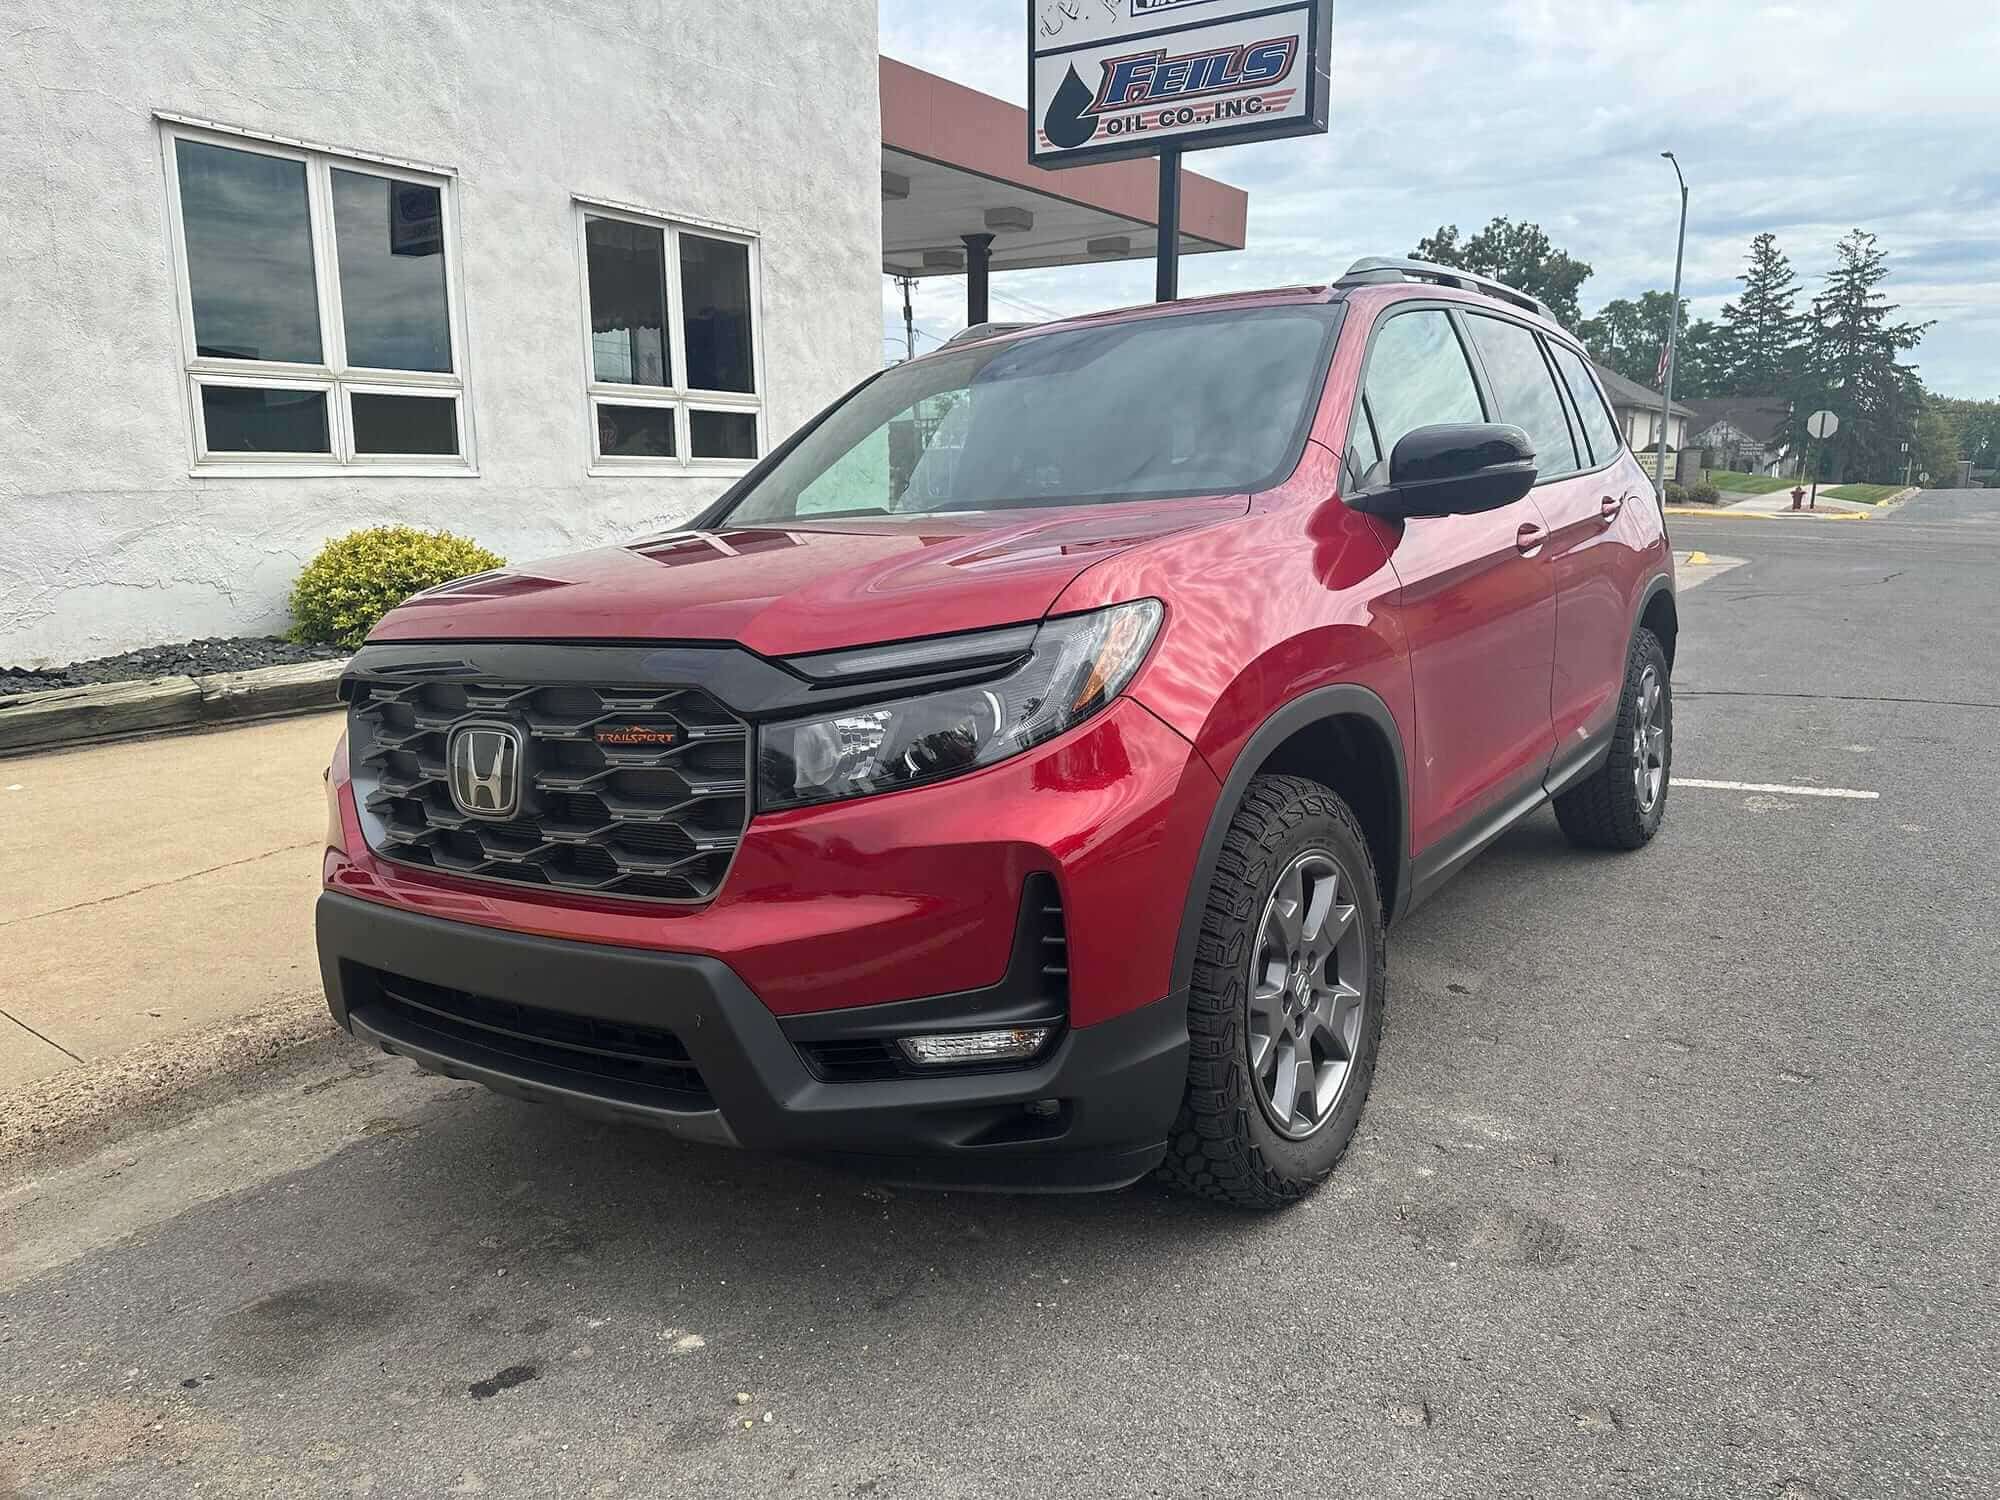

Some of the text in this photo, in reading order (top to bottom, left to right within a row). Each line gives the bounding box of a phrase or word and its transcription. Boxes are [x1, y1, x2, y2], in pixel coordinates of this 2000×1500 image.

[1094, 36, 1299, 111] FEILS
[1106, 115, 1148, 135] OIL
[597, 733, 674, 744] TRAILSPORT
